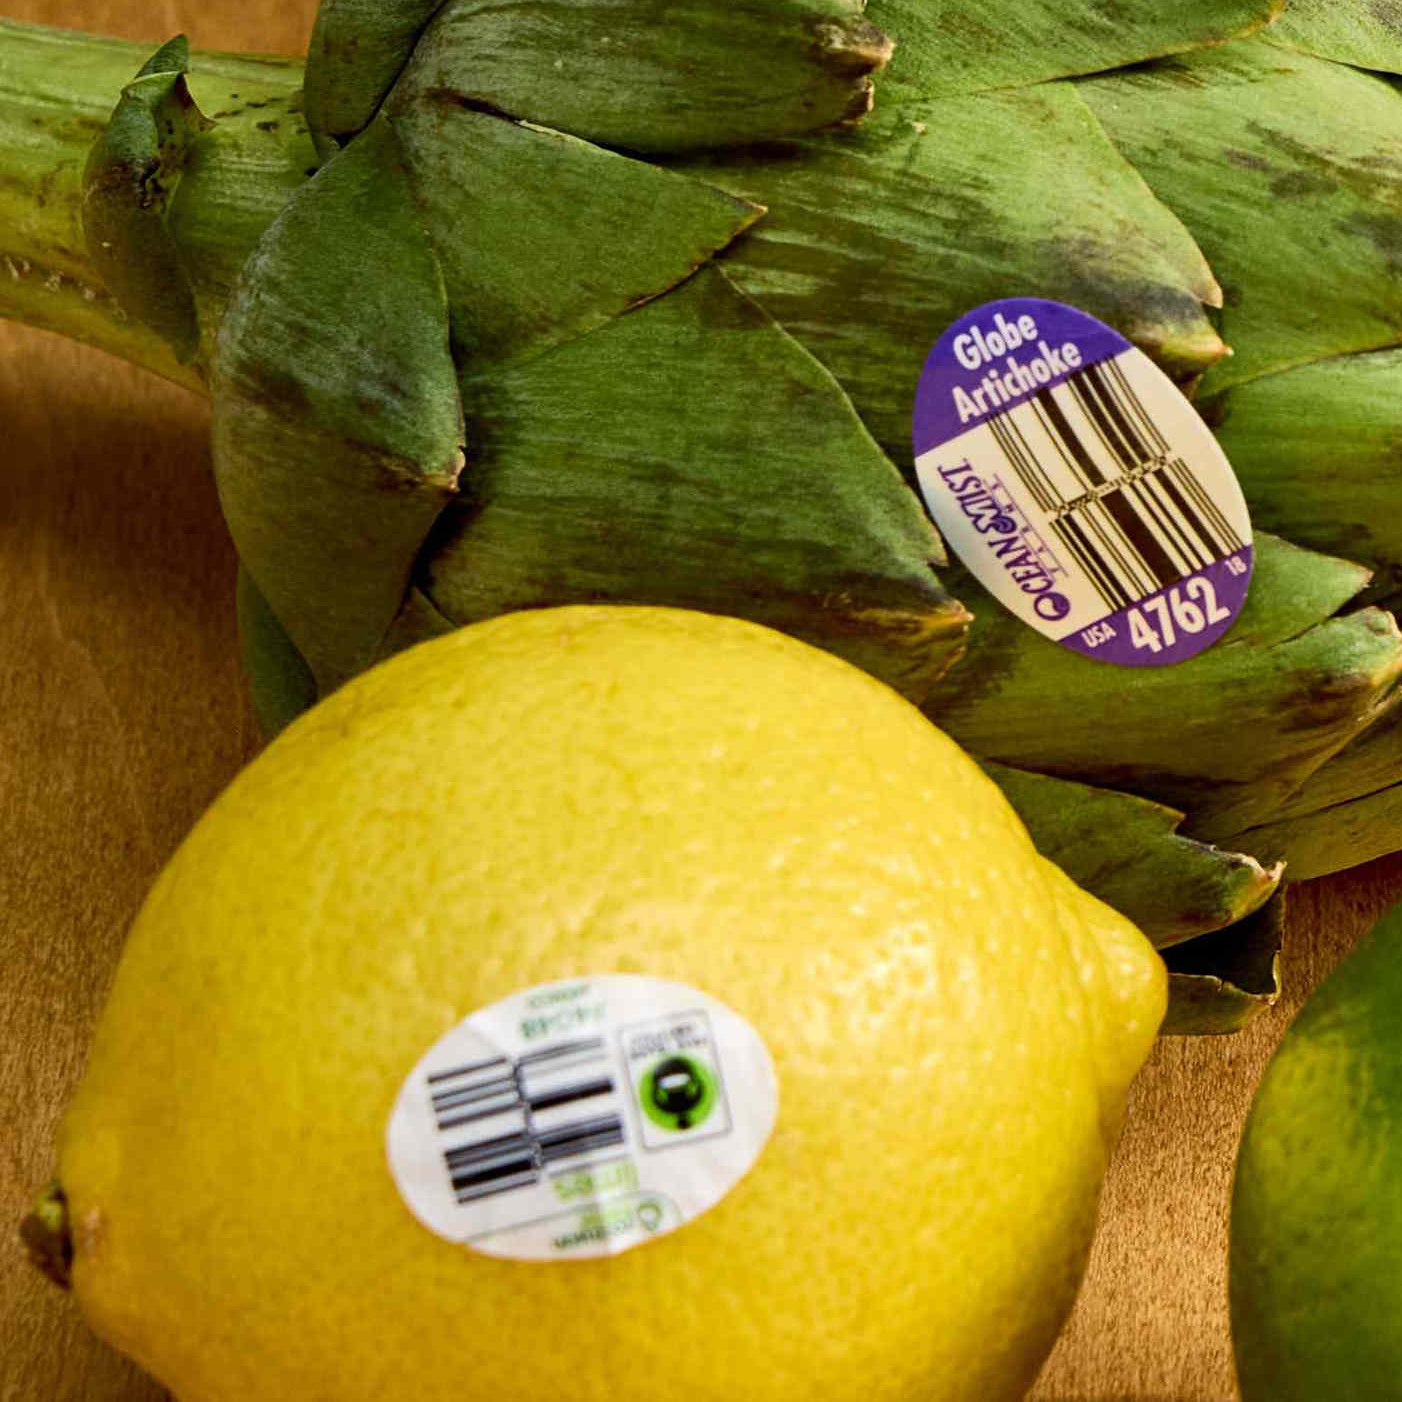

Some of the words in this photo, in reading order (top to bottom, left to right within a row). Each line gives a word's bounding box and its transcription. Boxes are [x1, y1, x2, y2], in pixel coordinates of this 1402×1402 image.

[952, 313, 1038, 370] Globe
[951, 339, 1083, 423] Artichoke
[987, 536, 1070, 621] OCEAN
[1127, 576, 1232, 653] 4762
[1081, 621, 1117, 648] USA
